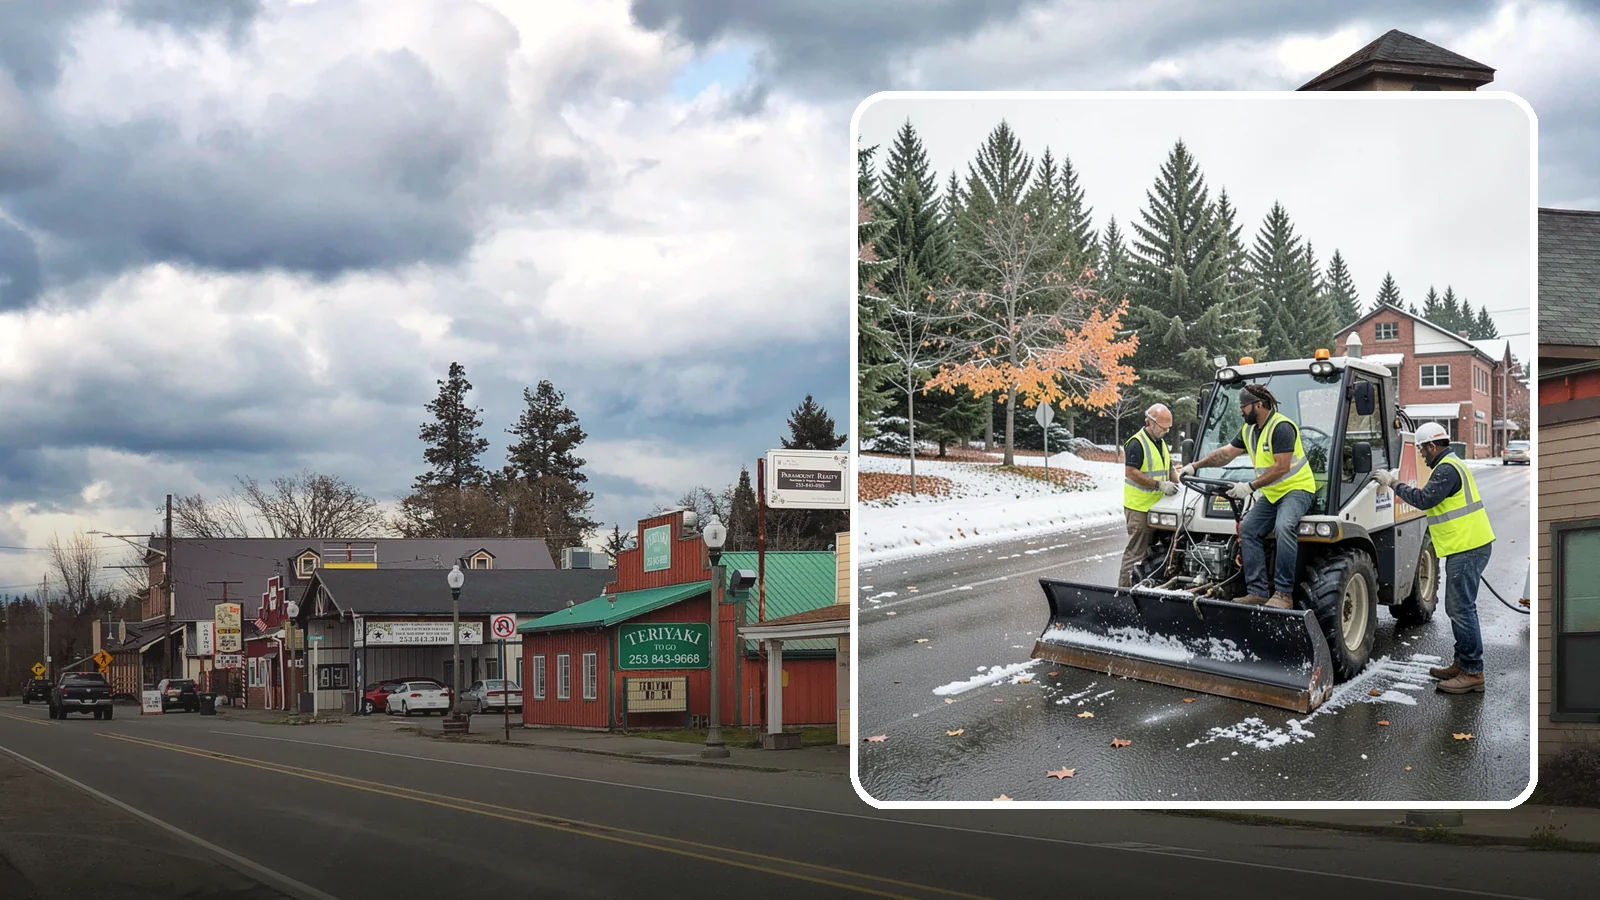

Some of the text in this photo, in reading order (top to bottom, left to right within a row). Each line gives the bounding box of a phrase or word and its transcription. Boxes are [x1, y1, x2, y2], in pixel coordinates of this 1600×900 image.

[781, 471, 815, 479] PARAMOUNT
[625, 627, 702, 646] TERIYAKI
[629, 653, 700, 664] 253 843-9668
